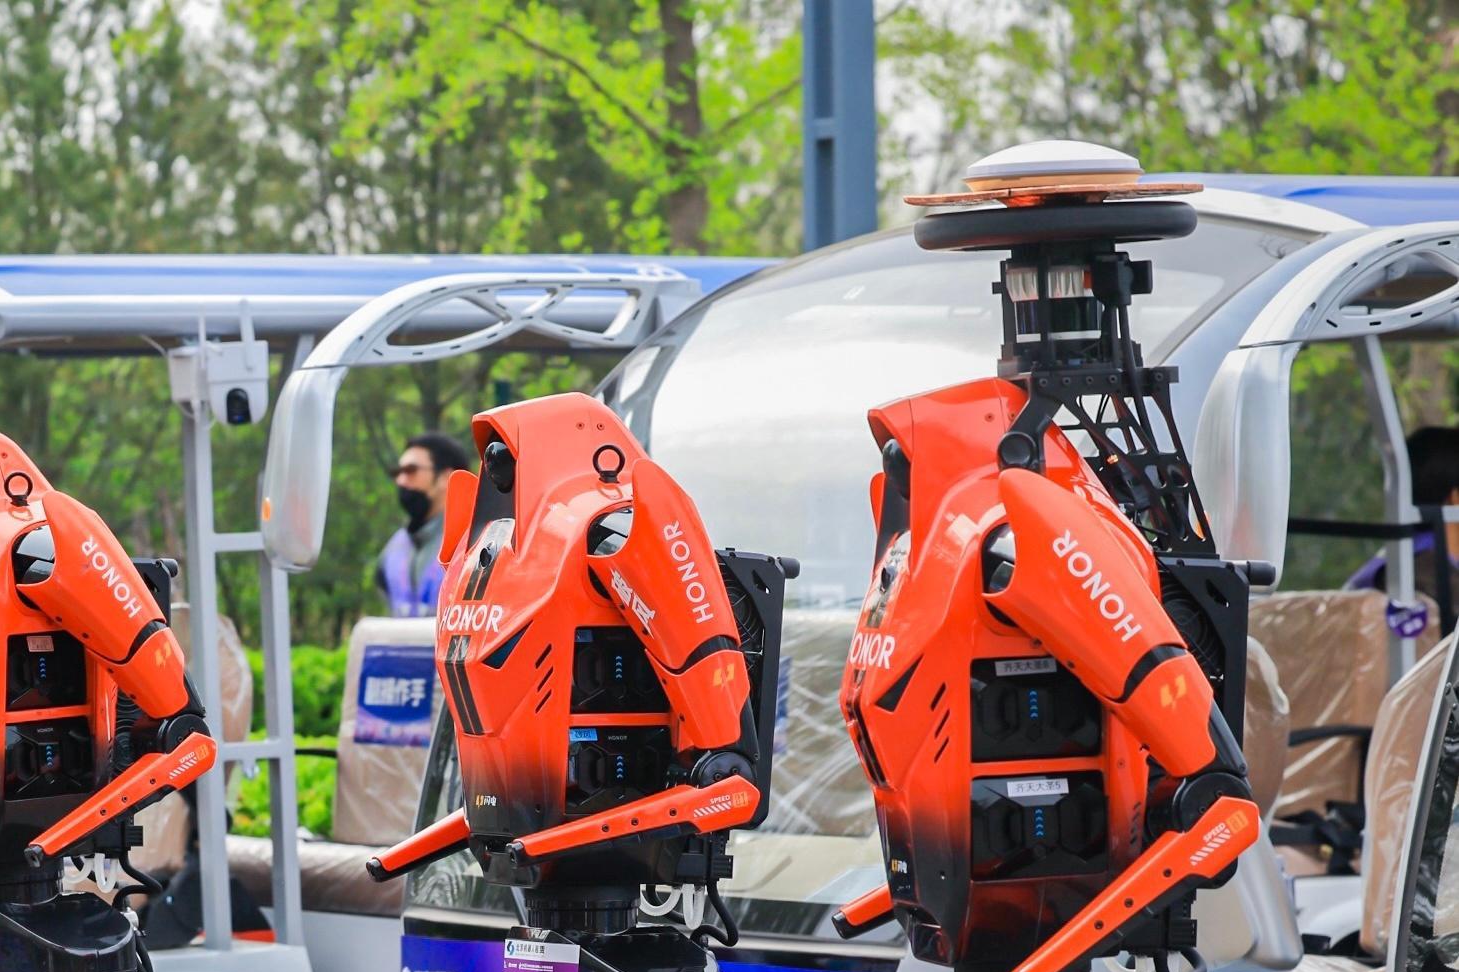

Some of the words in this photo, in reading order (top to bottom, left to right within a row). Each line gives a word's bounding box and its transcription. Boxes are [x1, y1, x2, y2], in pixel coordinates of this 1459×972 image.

[81, 534, 143, 620] HONOR
[662, 519, 714, 625] HONOR
[1052, 527, 1143, 645] HONOR
[439, 604, 505, 632] HONOR
[847, 632, 896, 670] ONOR
[709, 794, 731, 805] SPEED
[1202, 822, 1226, 843] SPEED
